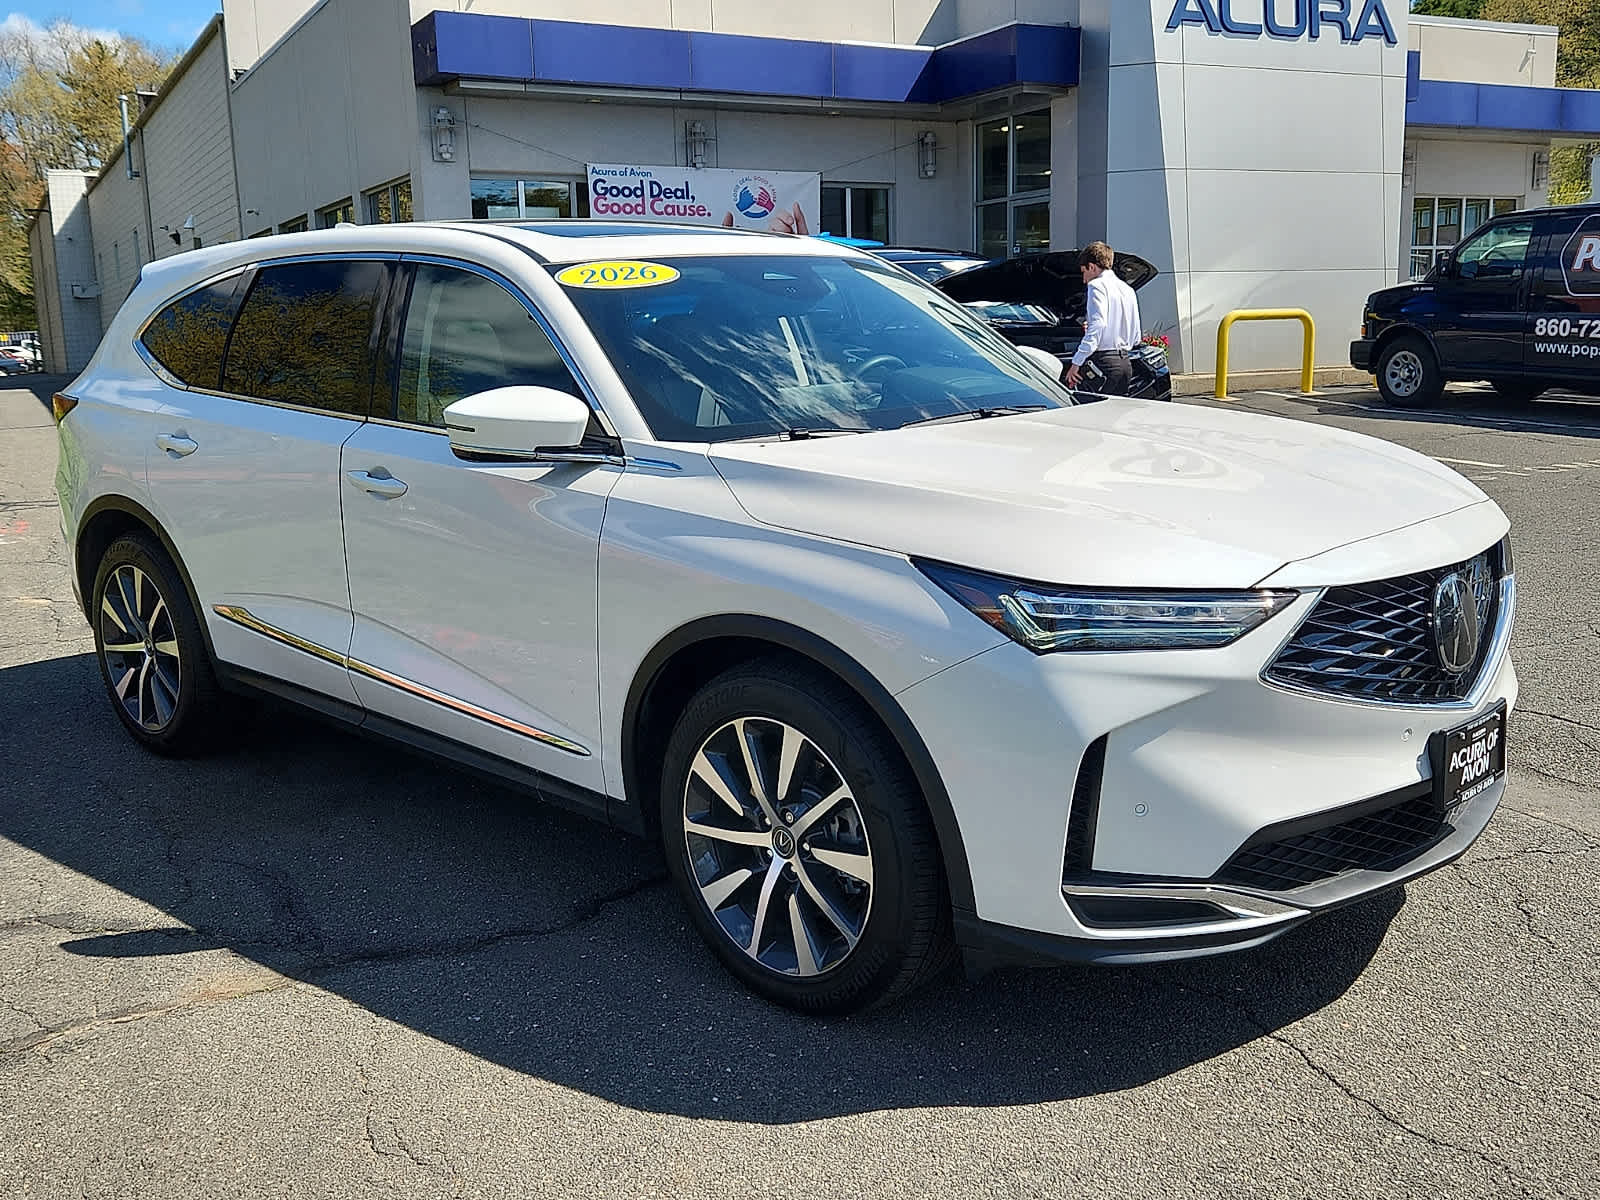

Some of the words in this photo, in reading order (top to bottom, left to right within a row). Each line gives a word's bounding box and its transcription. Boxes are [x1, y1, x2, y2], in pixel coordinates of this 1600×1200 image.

[1165, 0, 1398, 45] ACURA
[591, 166, 617, 176] Acura
[619, 167, 629, 176] of
[630, 168, 652, 178] Avon
[592, 178, 645, 198] Good
[649, 180, 696, 204] Deal,
[593, 195, 646, 216] Good
[649, 197, 712, 218] Cause.
[580, 266, 658, 284] 2026
[1535, 318, 1600, 338] 860-72
[1535, 342, 1600, 358] www.pop
[1448, 738, 1487, 773] ACURA
[1487, 728, 1500, 751] OF
[1460, 752, 1490, 786] AVON
